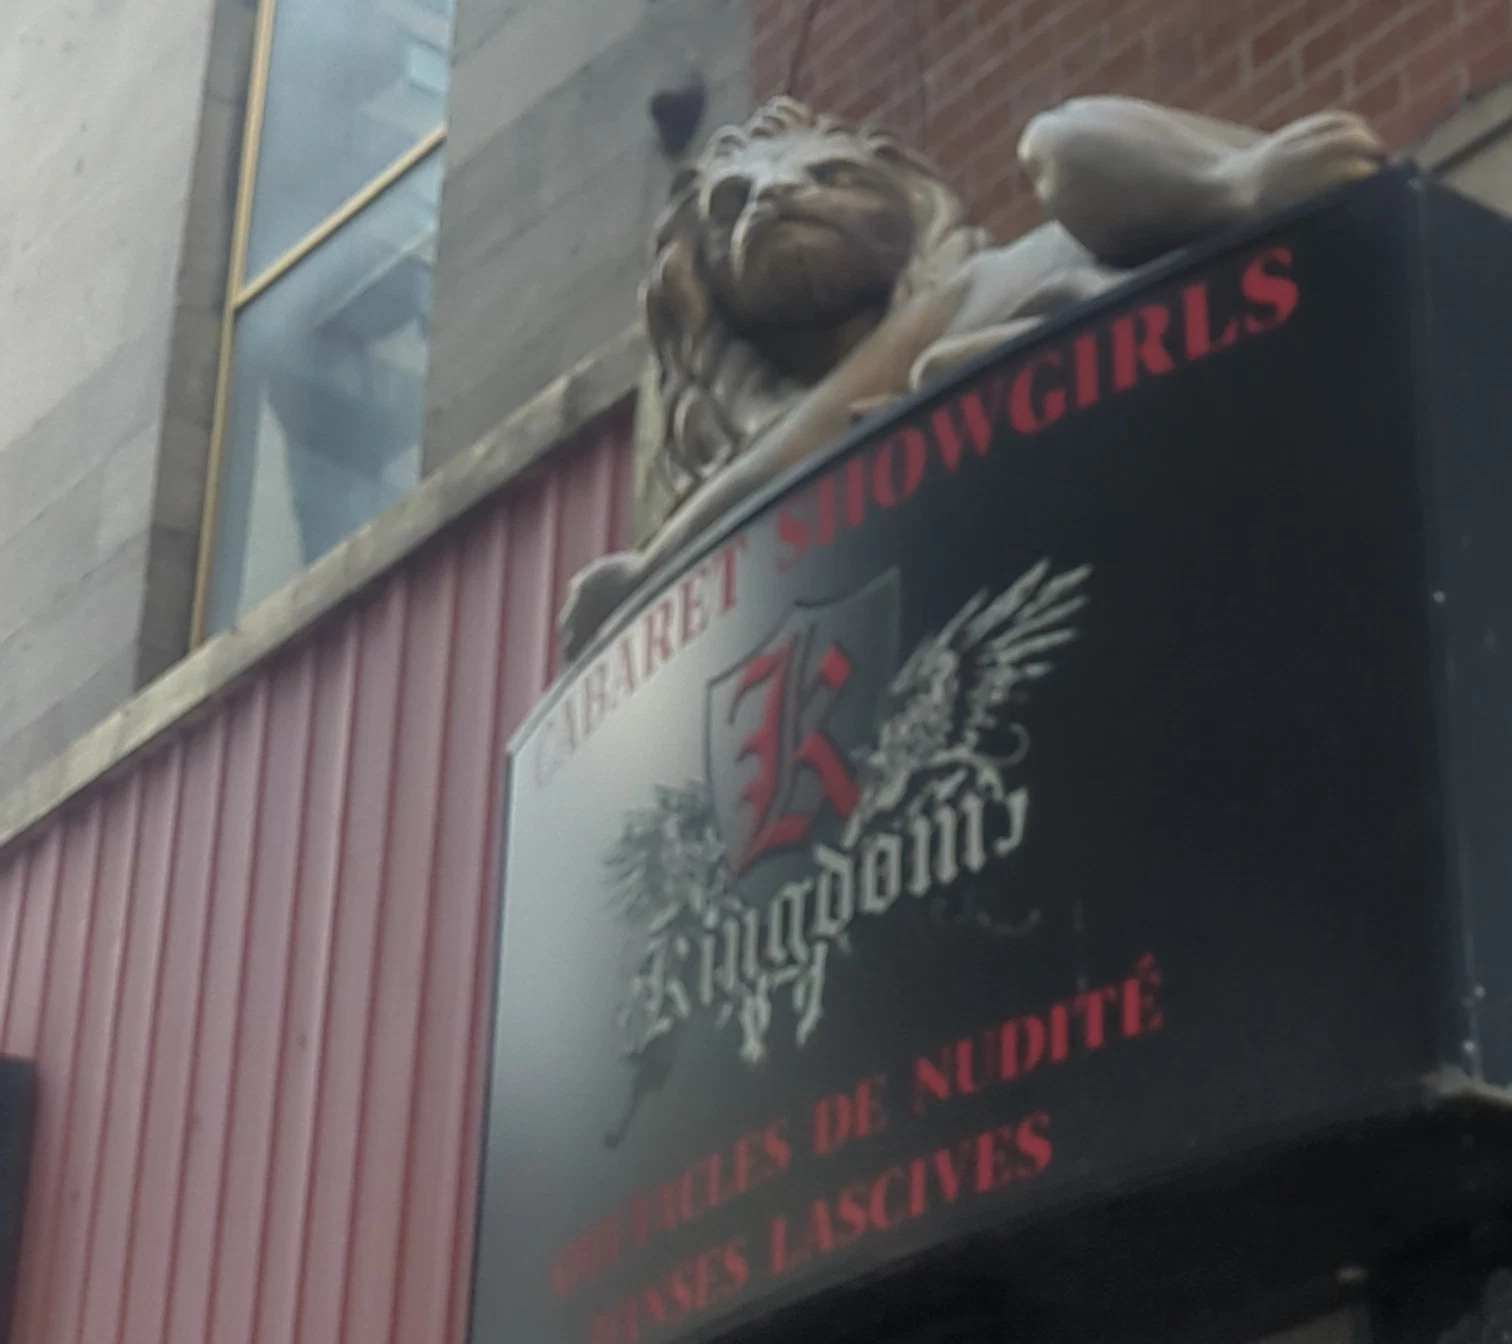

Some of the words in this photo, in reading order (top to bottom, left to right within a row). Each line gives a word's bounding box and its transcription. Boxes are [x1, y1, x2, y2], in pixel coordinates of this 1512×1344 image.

[776, 244, 1301, 574] SHOWGIRLS
[812, 1073, 889, 1157] DE
[911, 951, 1166, 1114] NUDITÉ
[768, 1111, 1055, 1279] LASCIVES
